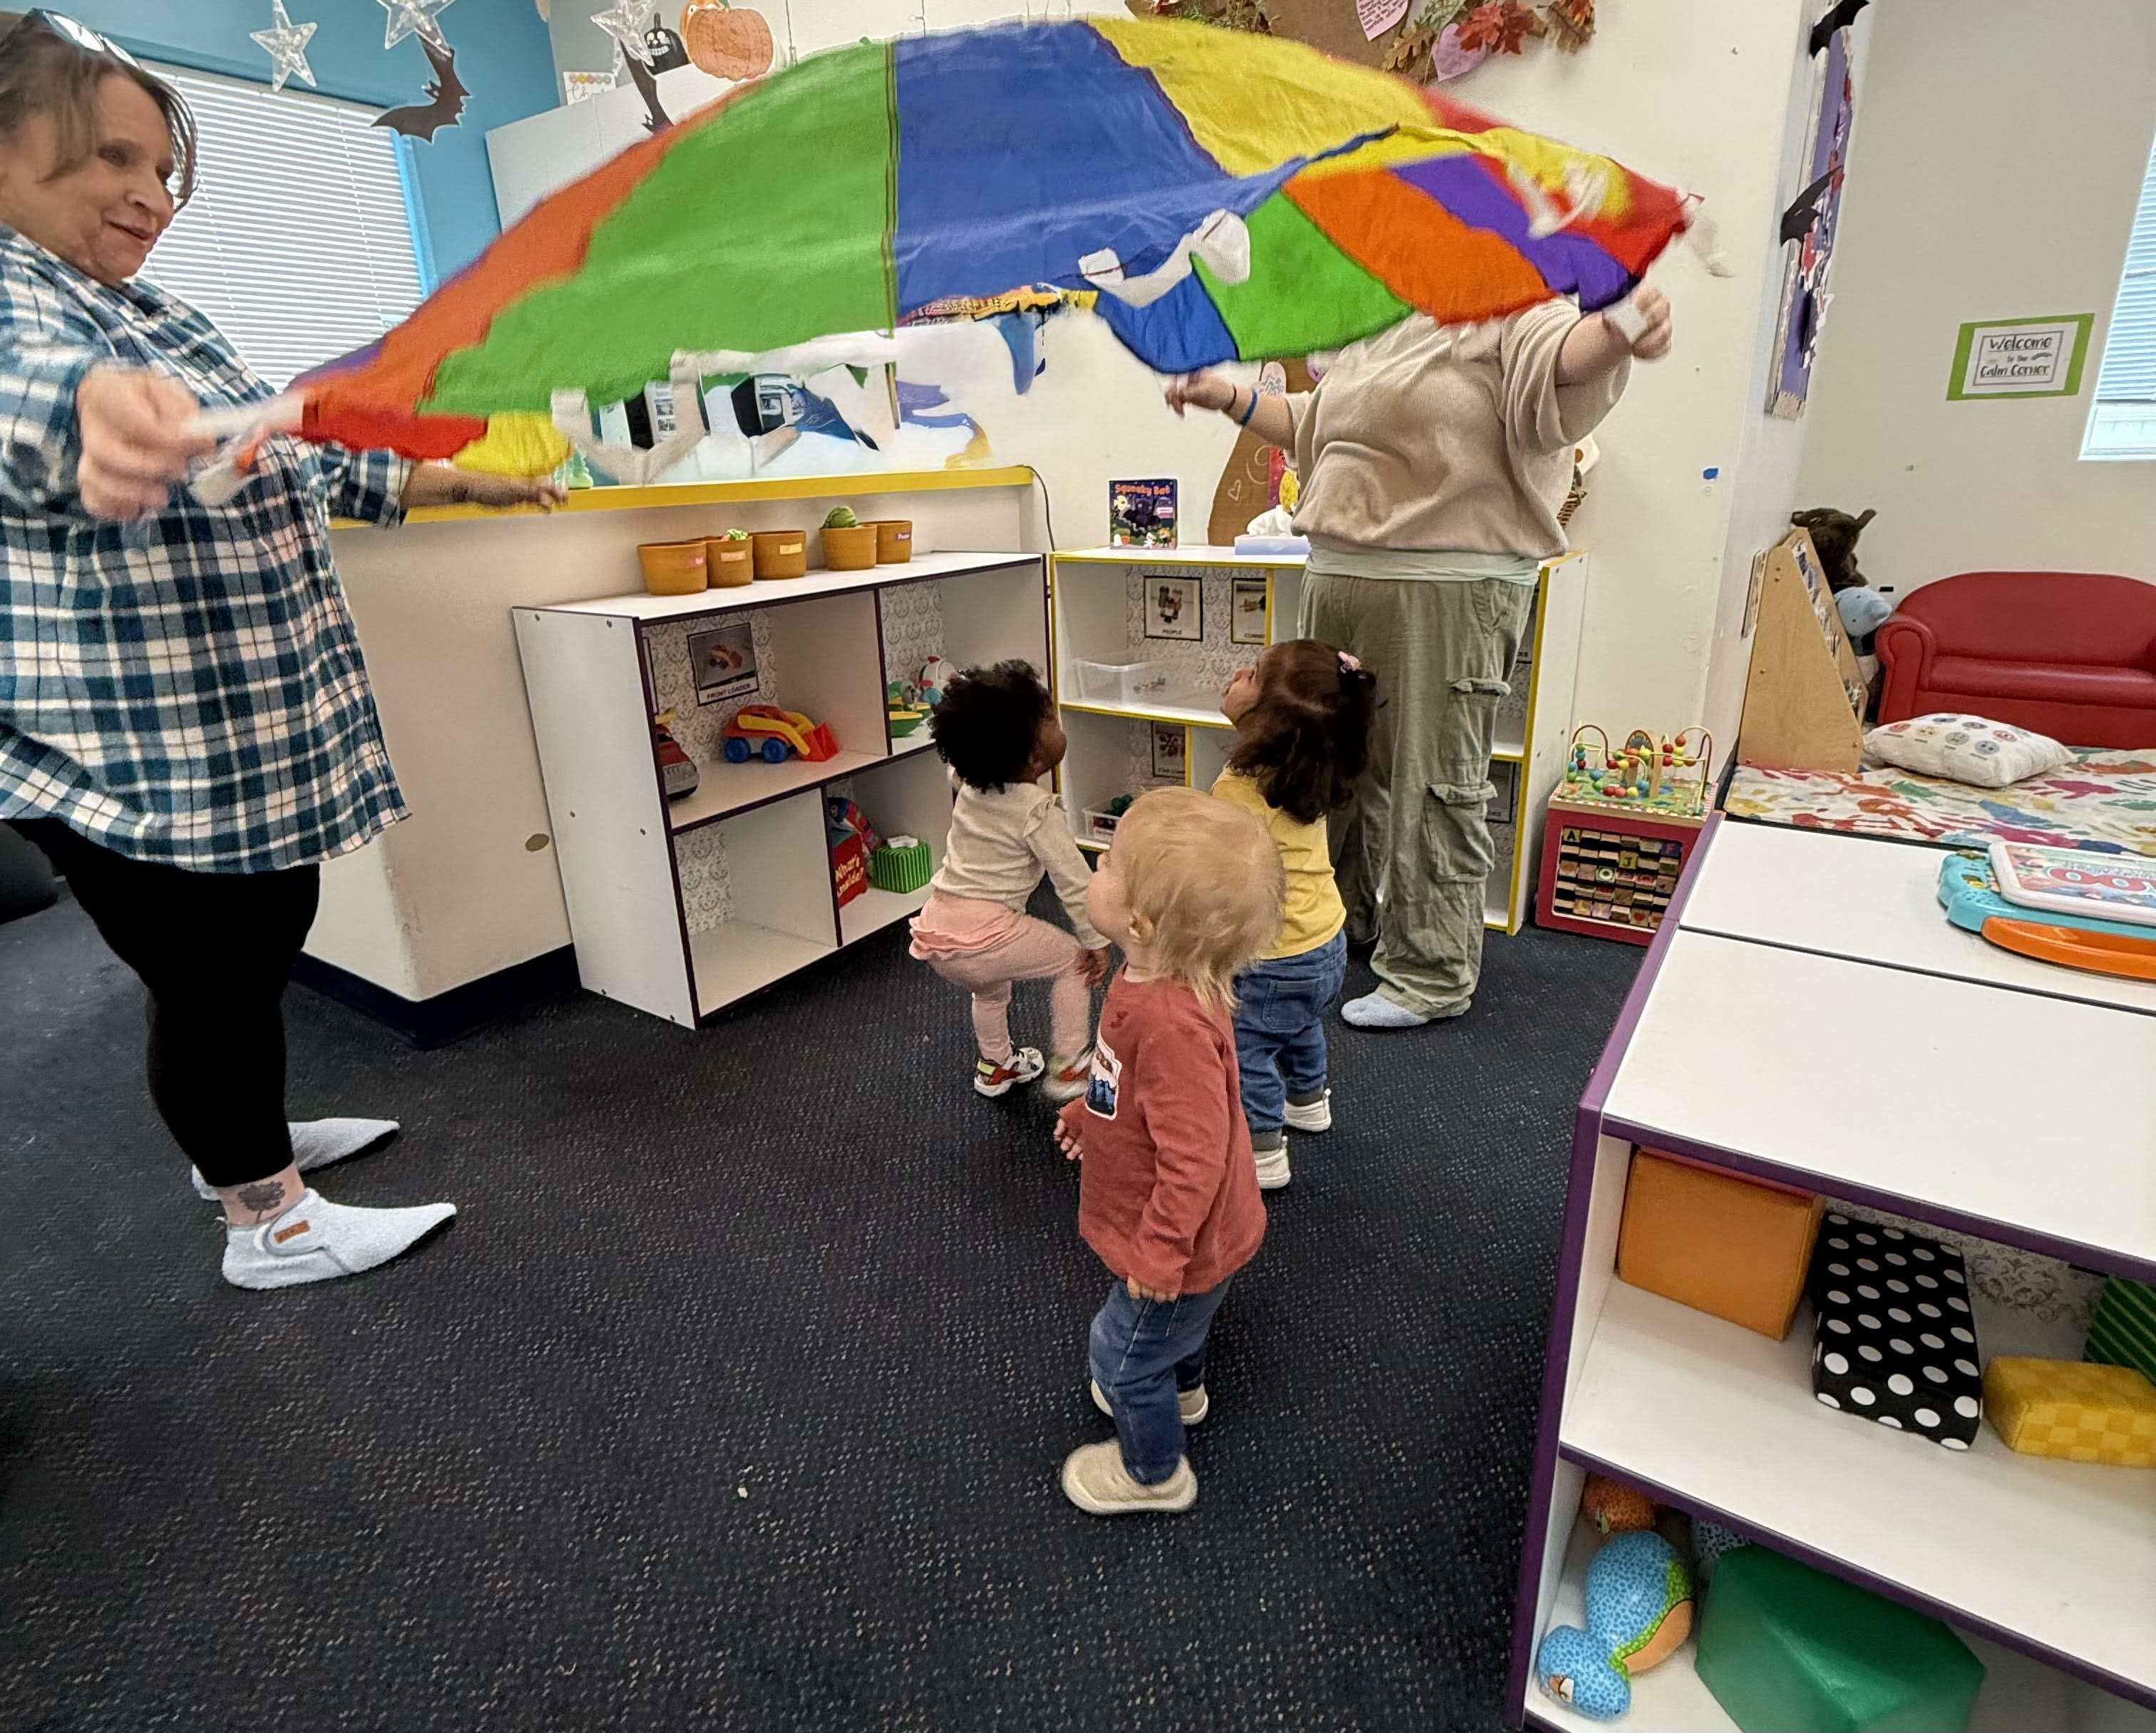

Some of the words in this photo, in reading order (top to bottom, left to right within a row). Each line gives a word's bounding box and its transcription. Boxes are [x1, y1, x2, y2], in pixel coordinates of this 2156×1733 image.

[1989, 336, 2053, 350] Welcome
[1980, 364, 2008, 378] Calm
[2011, 364, 2050, 377] Corner
[1566, 830, 1576, 841] A
